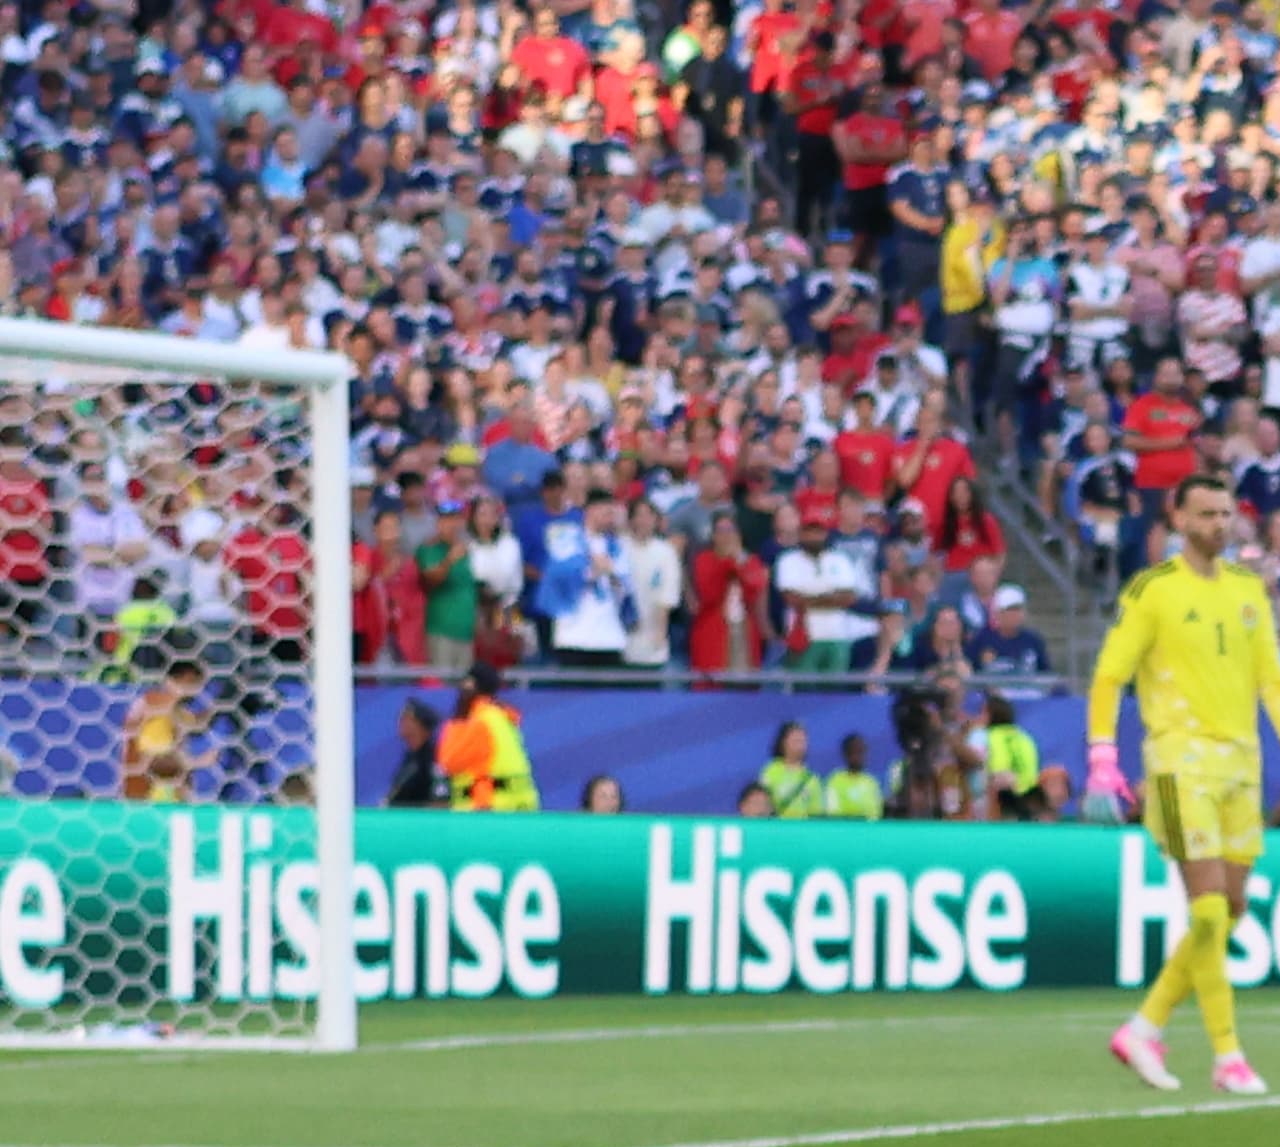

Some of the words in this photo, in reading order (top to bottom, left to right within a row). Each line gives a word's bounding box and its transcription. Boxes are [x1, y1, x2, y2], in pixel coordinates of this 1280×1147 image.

[1214, 622, 1229, 657] 1
[167, 812, 561, 1000] Hisense
[644, 824, 1027, 993] Hisense
